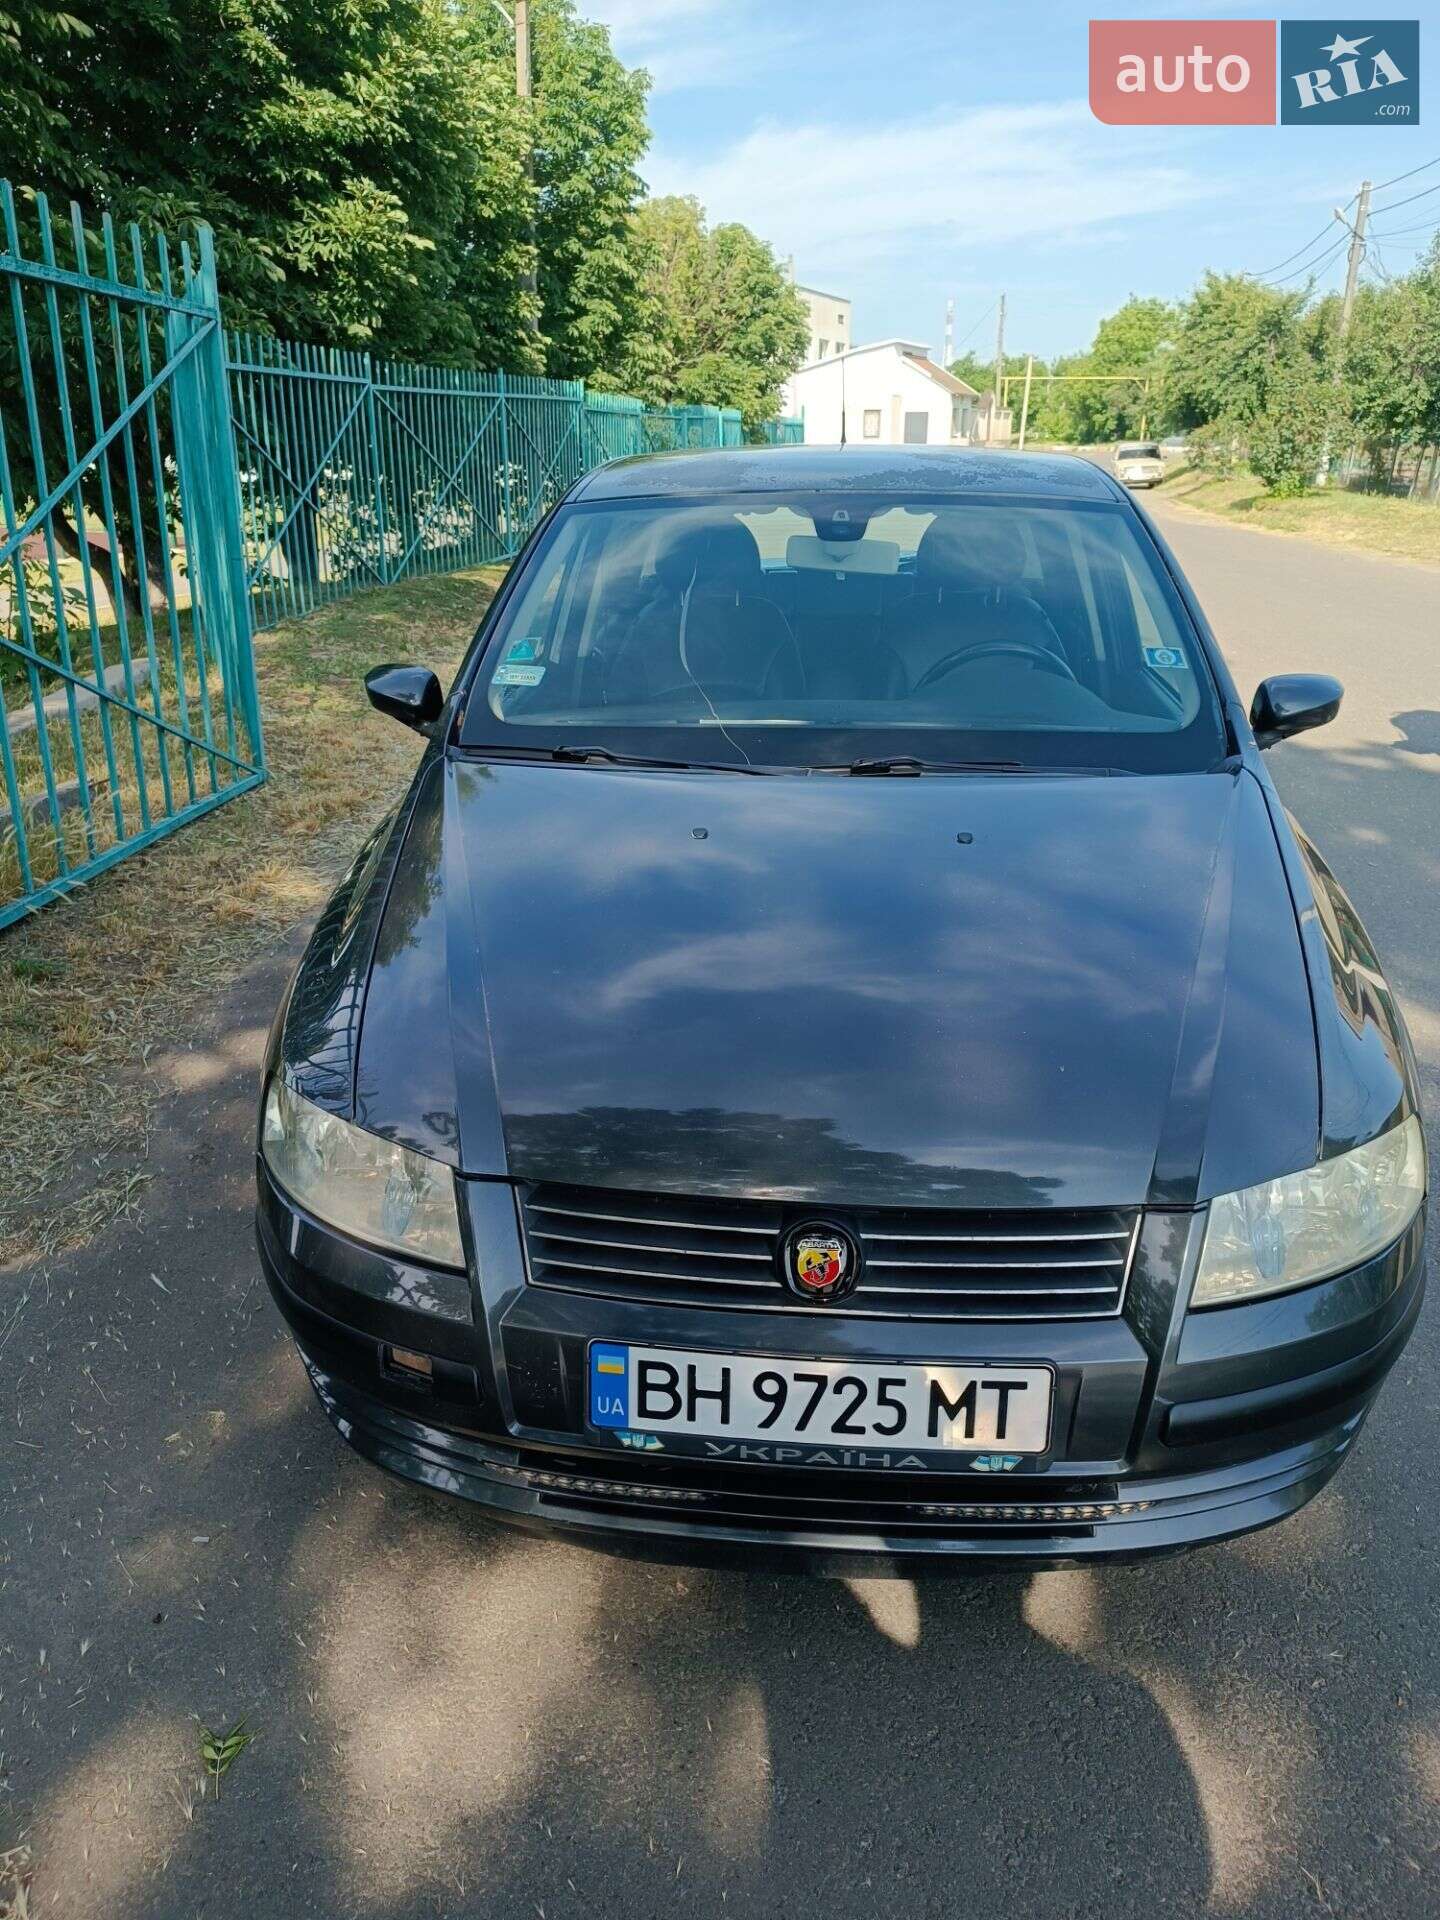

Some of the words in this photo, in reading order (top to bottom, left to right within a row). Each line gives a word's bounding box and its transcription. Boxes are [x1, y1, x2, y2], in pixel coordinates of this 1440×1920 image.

[597, 1396, 624, 1416] UA
[637, 1359, 731, 1425] BH
[752, 1371, 908, 1436] 9725
[927, 1380, 1028, 1440] MT
[705, 1442, 929, 1470] УКРАЇНА
